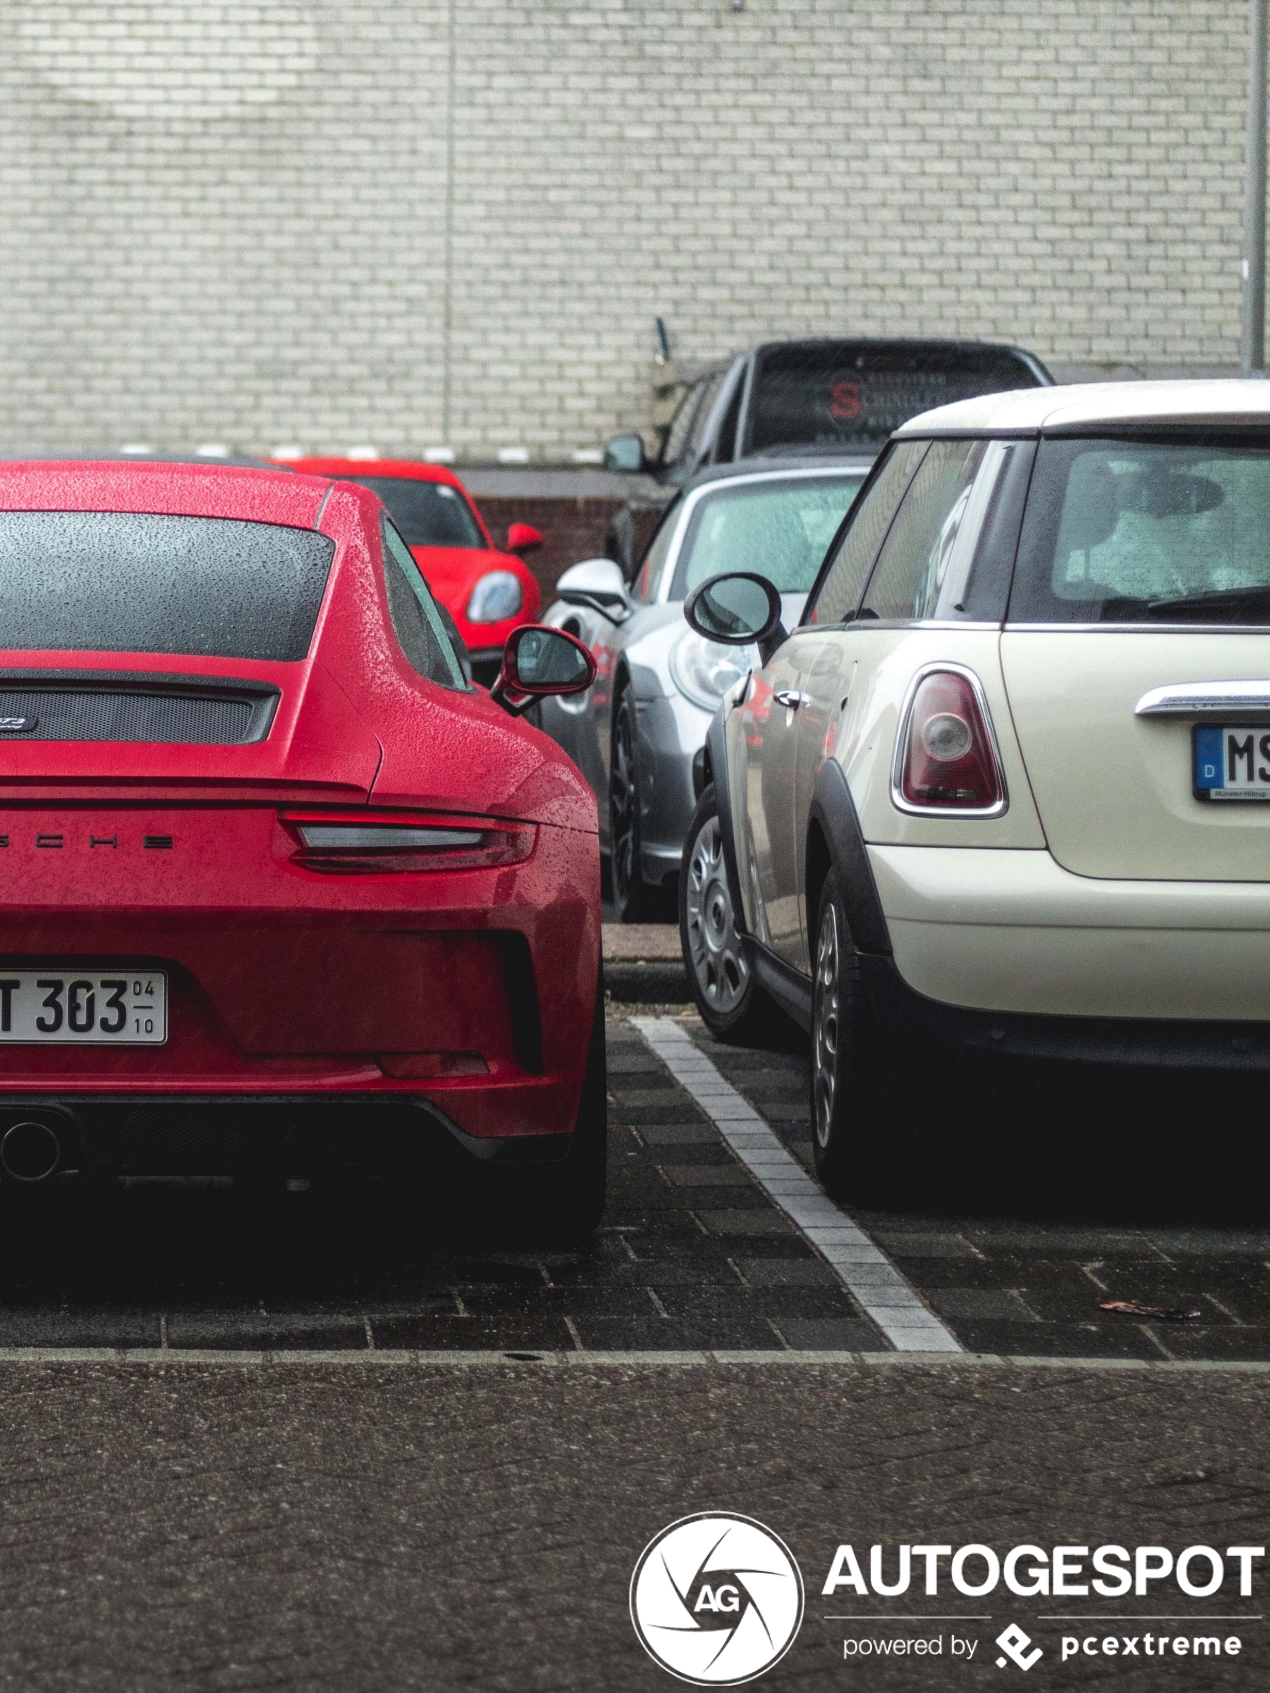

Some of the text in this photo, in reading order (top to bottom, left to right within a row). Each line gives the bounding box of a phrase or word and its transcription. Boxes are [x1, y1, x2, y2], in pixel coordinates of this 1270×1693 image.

[1228, 734, 1270, 782] MS
[1204, 764, 1215, 778] D
[133, 985, 154, 996] 04
[36, 979, 127, 1033] 303
[135, 1019, 153, 1034] 10
